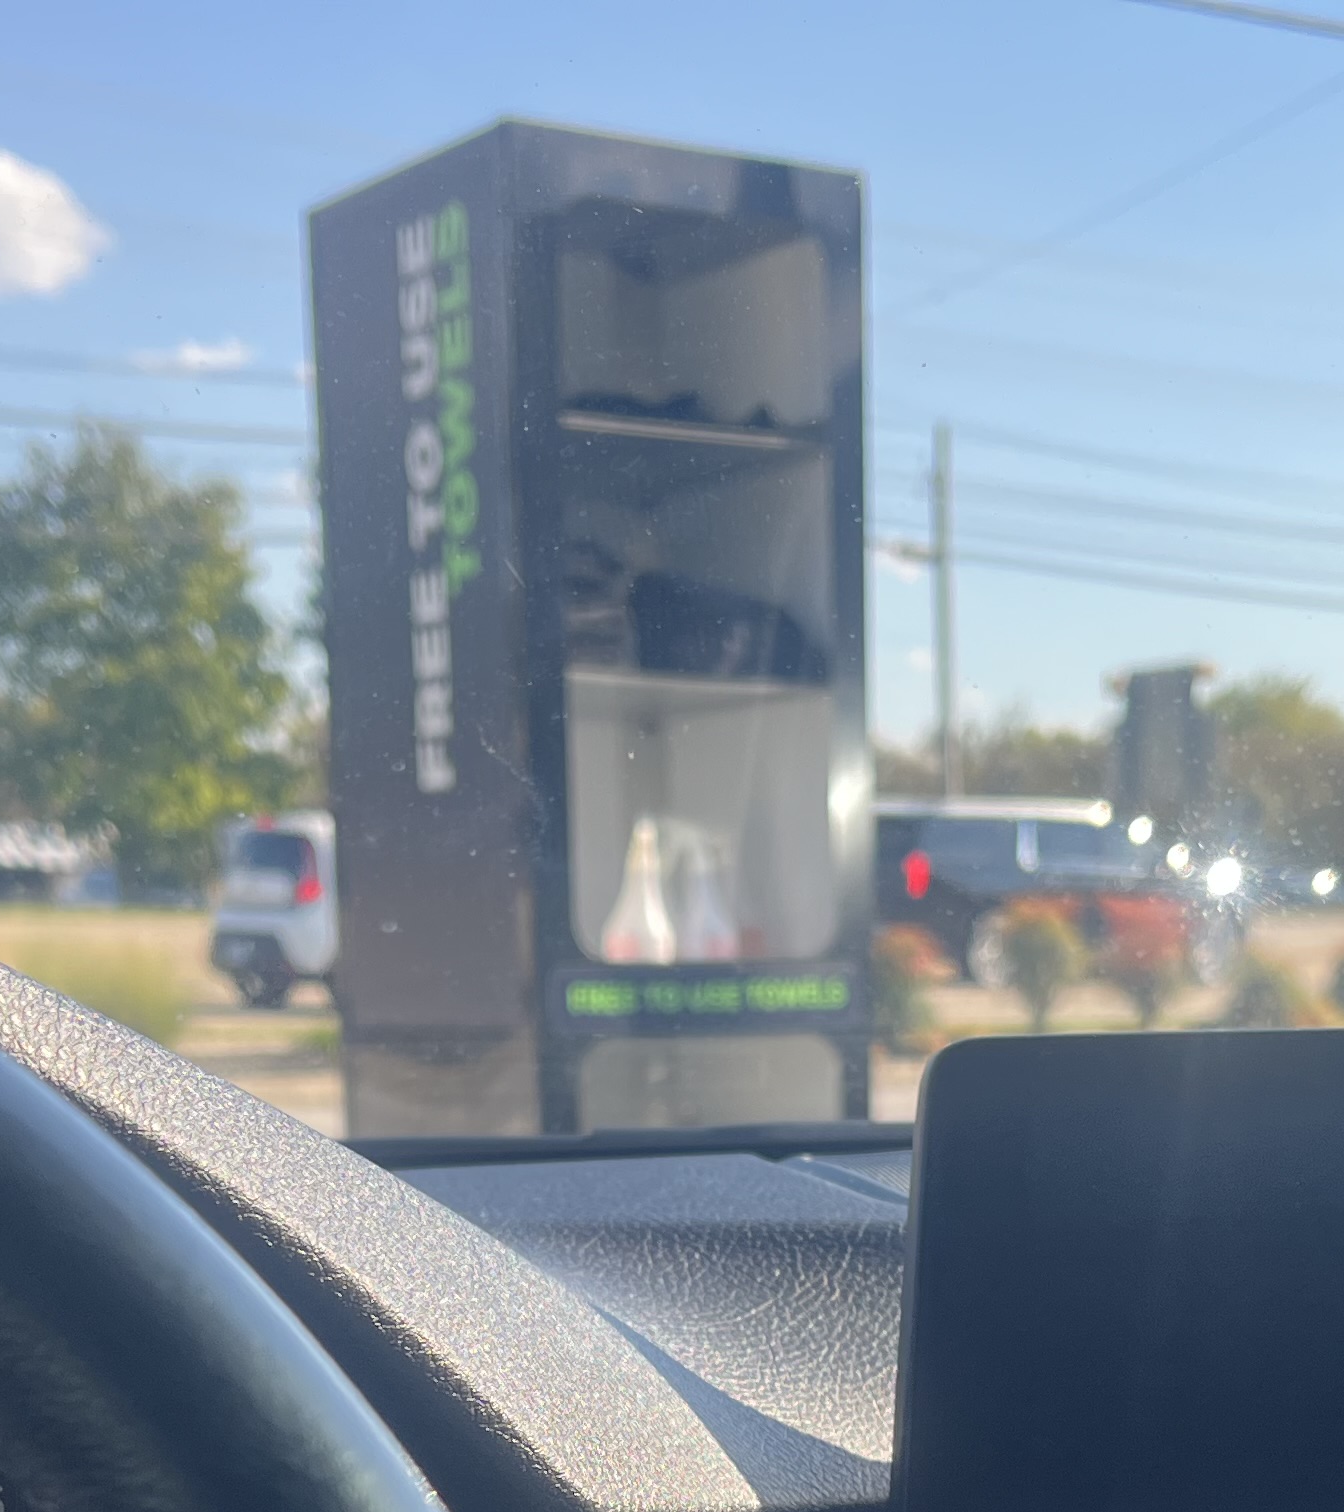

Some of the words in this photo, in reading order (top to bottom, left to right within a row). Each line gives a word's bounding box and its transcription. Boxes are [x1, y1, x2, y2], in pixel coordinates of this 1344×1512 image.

[396, 216, 438, 399] USE
[434, 202, 480, 594] TOWELS
[405, 422, 444, 549] TO
[410, 573, 454, 792] FREE
